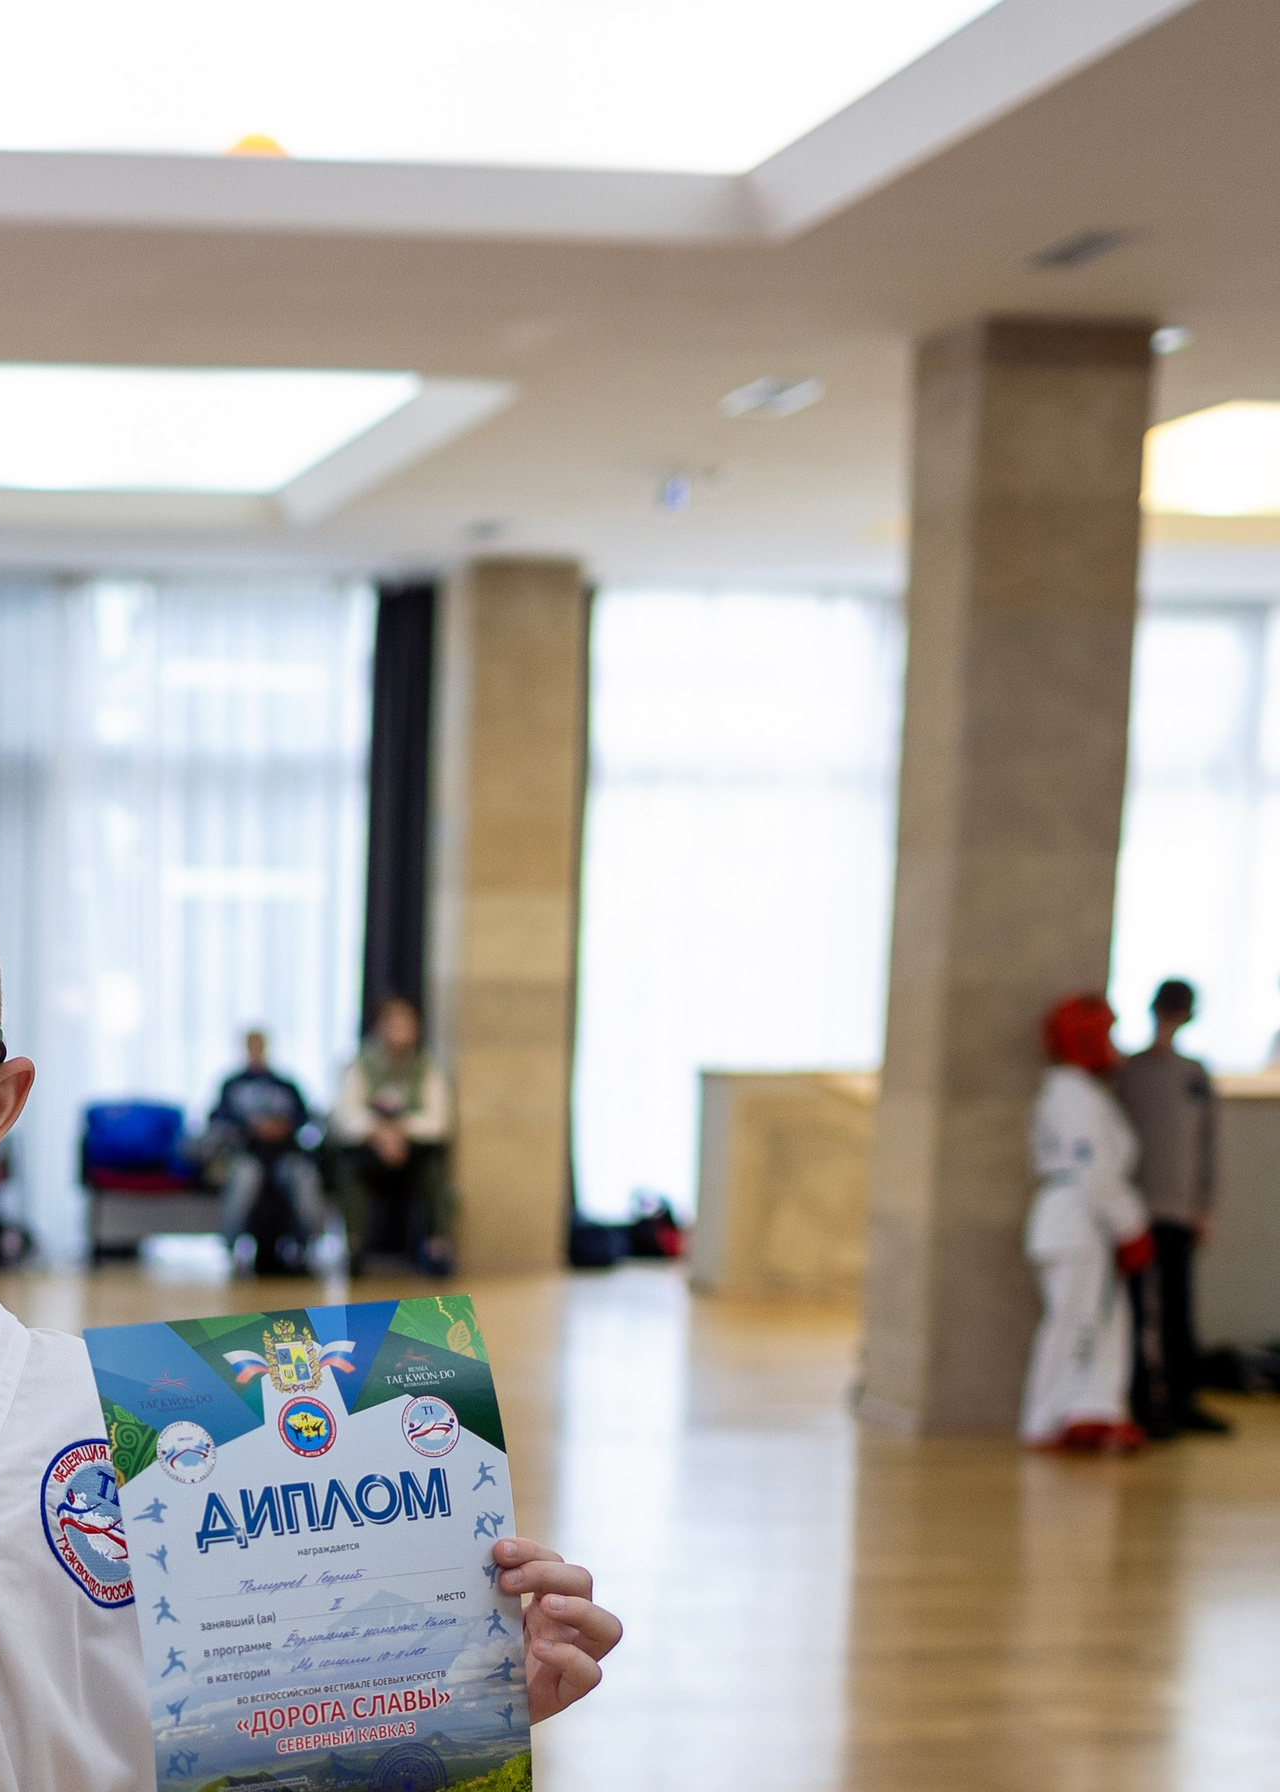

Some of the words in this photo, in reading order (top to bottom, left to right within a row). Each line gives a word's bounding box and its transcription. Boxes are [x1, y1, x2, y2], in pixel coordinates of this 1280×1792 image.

[385, 1374, 404, 1384] TAE
[53, 1444, 106, 1483] ФЕДЕРАЦИЯ
[195, 1467, 450, 1554] ДИПЛОМ
[298, 1543, 360, 1556] награждается
[436, 1591, 466, 1602] место
[200, 1615, 255, 1631] занявший
[257, 1612, 276, 1624] (ая)
[213, 1641, 272, 1659] программе
[216, 1667, 271, 1685] категории
[237, 1696, 249, 1704] ВО
[251, 1686, 321, 1703] ВСЕРОССИЙСКОМ
[323, 1680, 370, 1694] ФЕСТИВАЛЕ
[373, 1675, 405, 1687] БОЕВЫХ
[406, 1669, 446, 1683] ИСКУССТВ
[237, 1699, 346, 1736] «ДОРОГА
[352, 1687, 451, 1719] СЛАВЫ»
[276, 1730, 356, 1755] СЕВЕРНЫЙ
[358, 1721, 416, 1743] КАВКАЗ
